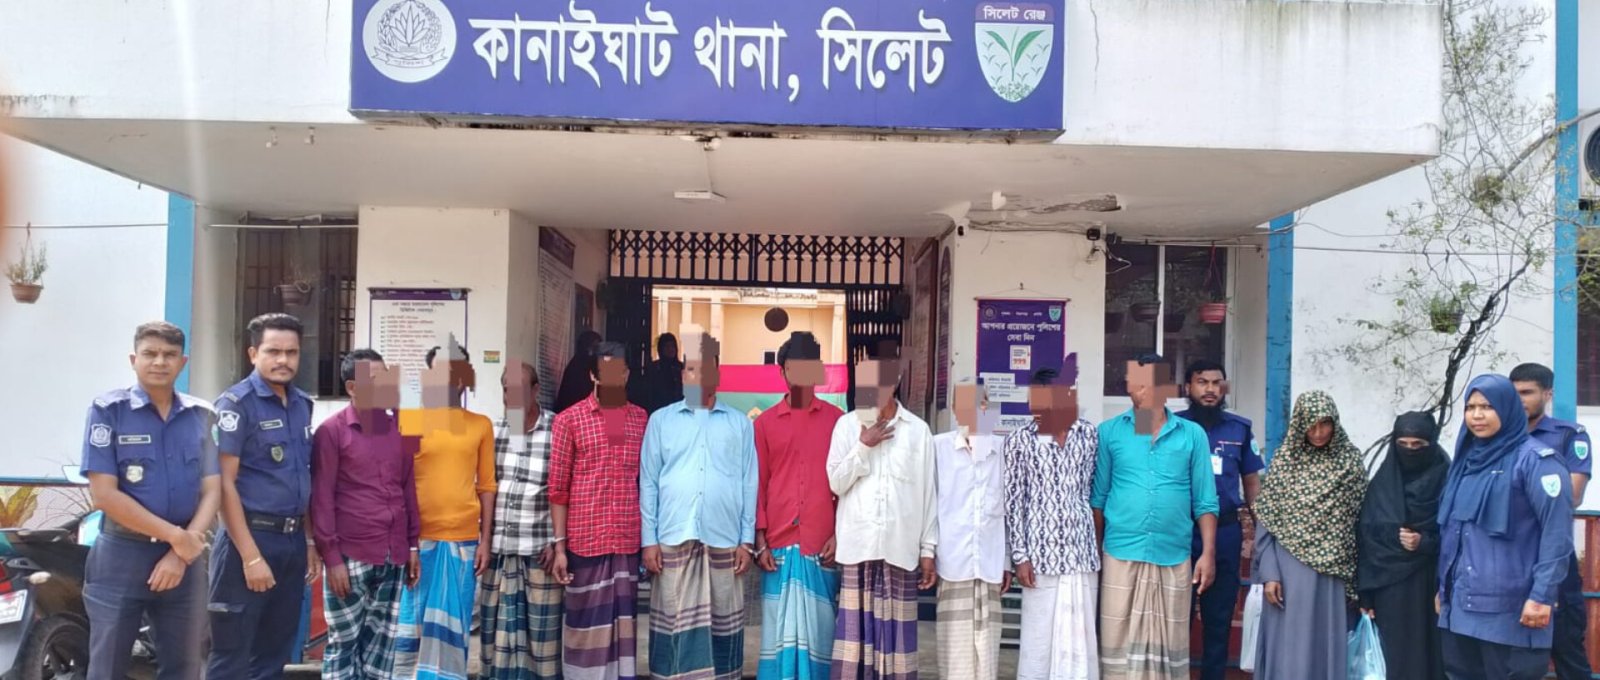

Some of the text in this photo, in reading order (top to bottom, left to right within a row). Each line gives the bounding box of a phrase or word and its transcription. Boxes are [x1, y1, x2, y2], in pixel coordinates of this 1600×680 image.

[983, 5, 1046, 21] সিলেট রেঞ্জ
[468, 0, 952, 102] কানাইঘাট থানা, সিলেট
